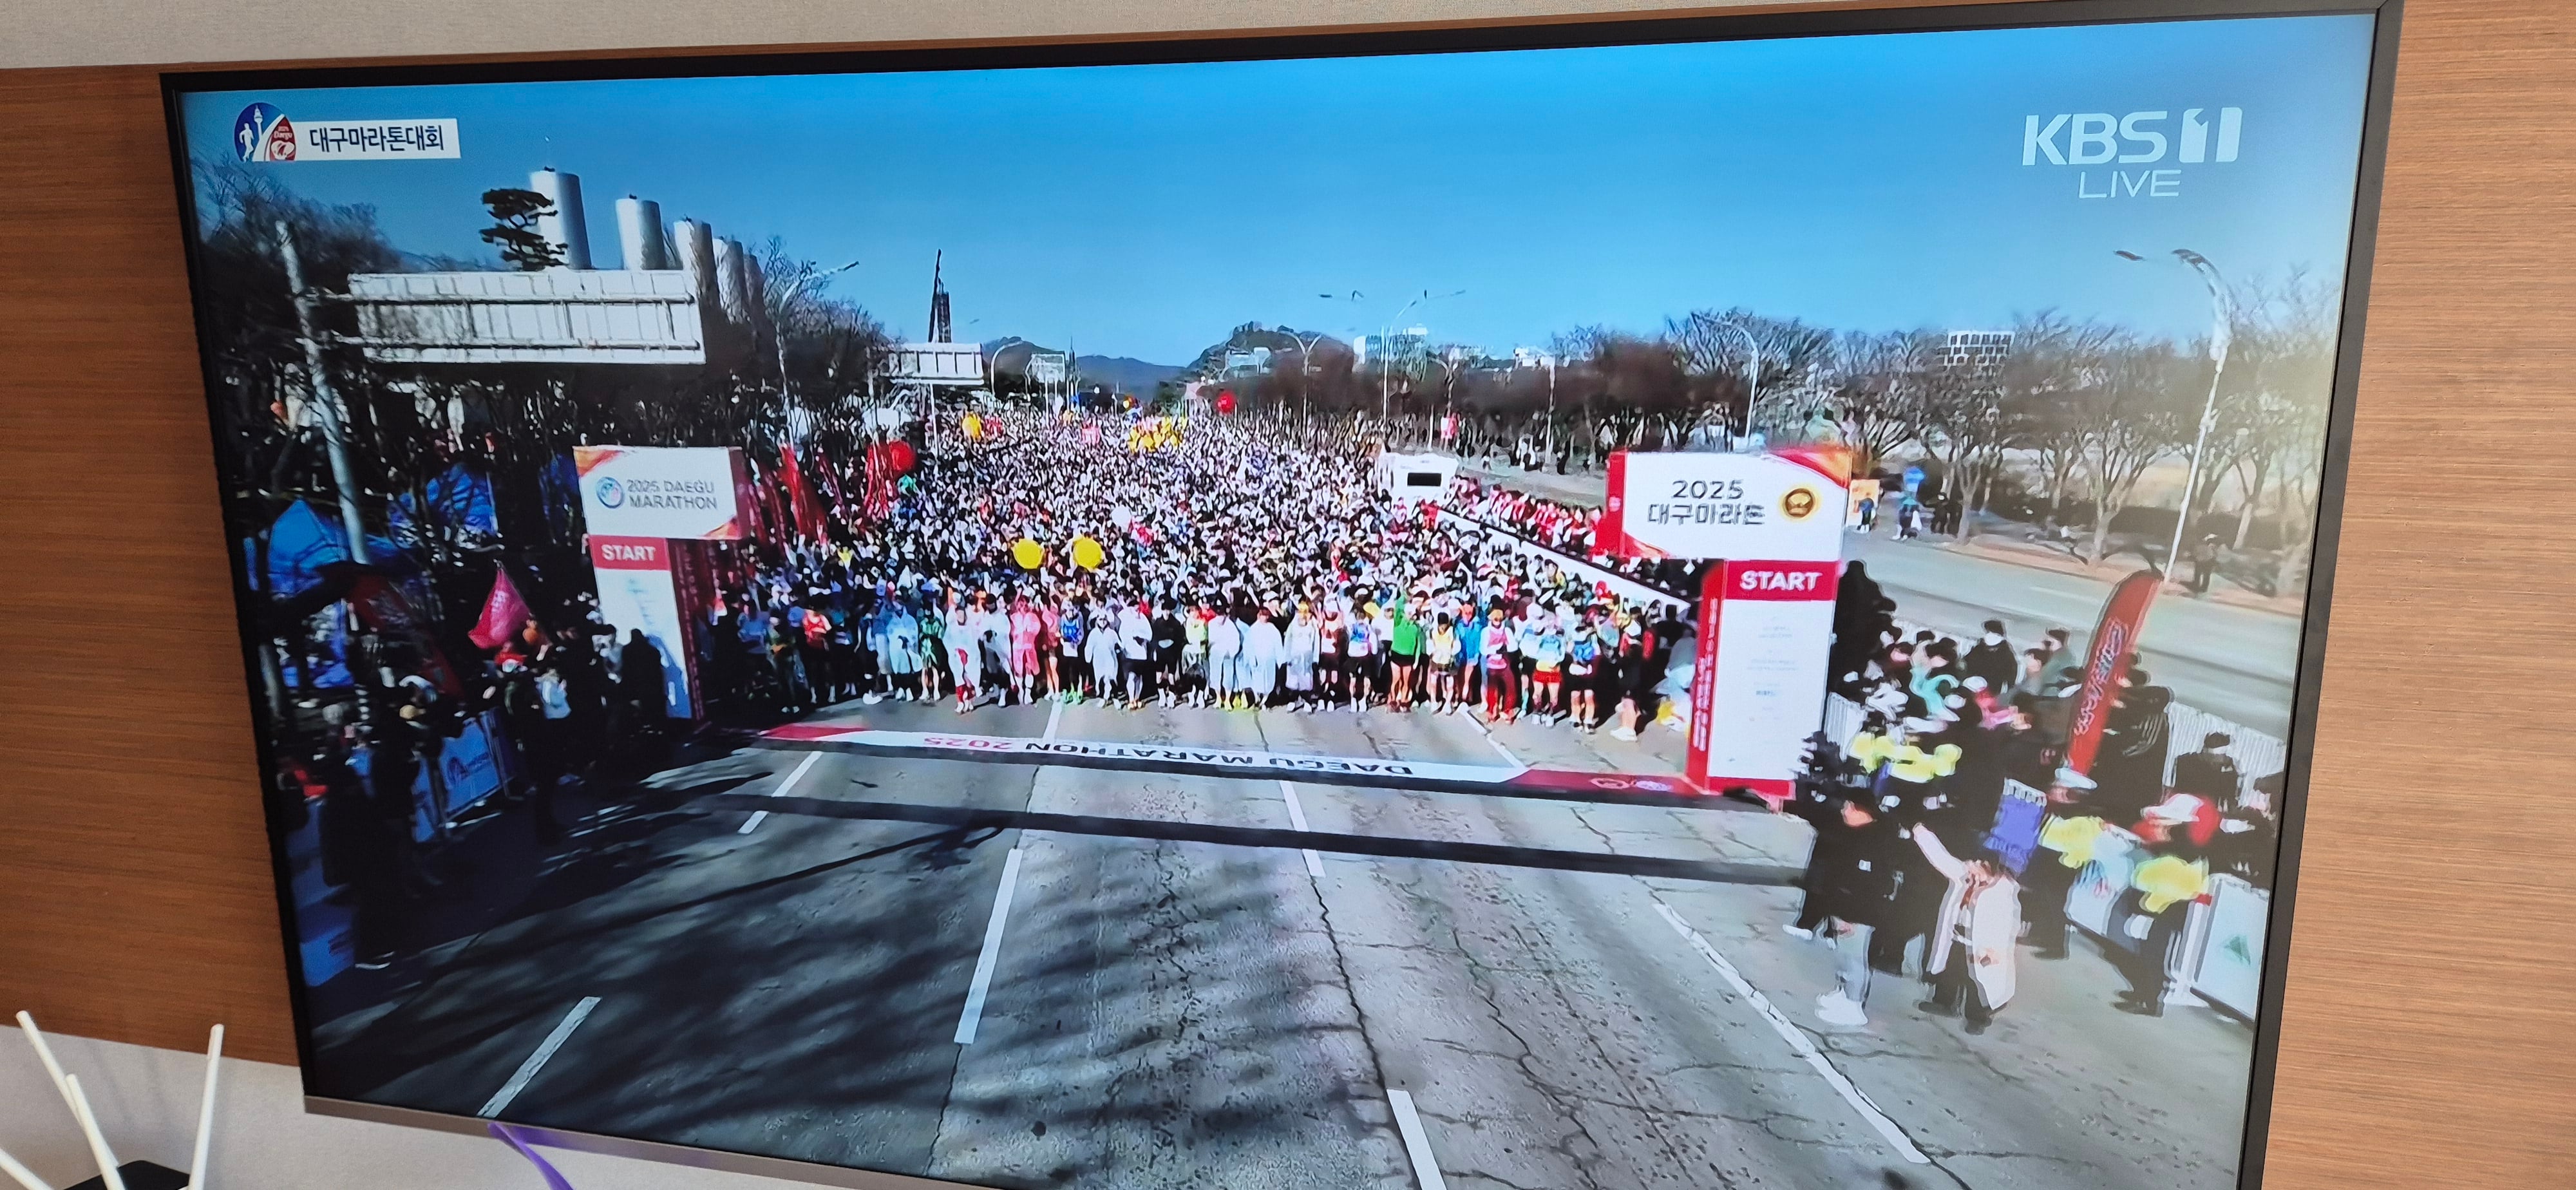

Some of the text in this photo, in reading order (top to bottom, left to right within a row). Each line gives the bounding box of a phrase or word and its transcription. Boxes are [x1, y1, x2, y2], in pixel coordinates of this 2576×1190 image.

[310, 126, 444, 153] 대구마라톤대회
[2079, 170, 2182, 198] LIVE
[627, 479, 714, 494] 2025 DAEGU
[1672, 479, 1745, 500] 2025
[630, 495, 717, 509] MARATHON
[601, 545, 656, 561] START
[1739, 571, 1823, 590] START
[923, 737, 1414, 775] DAEGU MARATHON 2025
